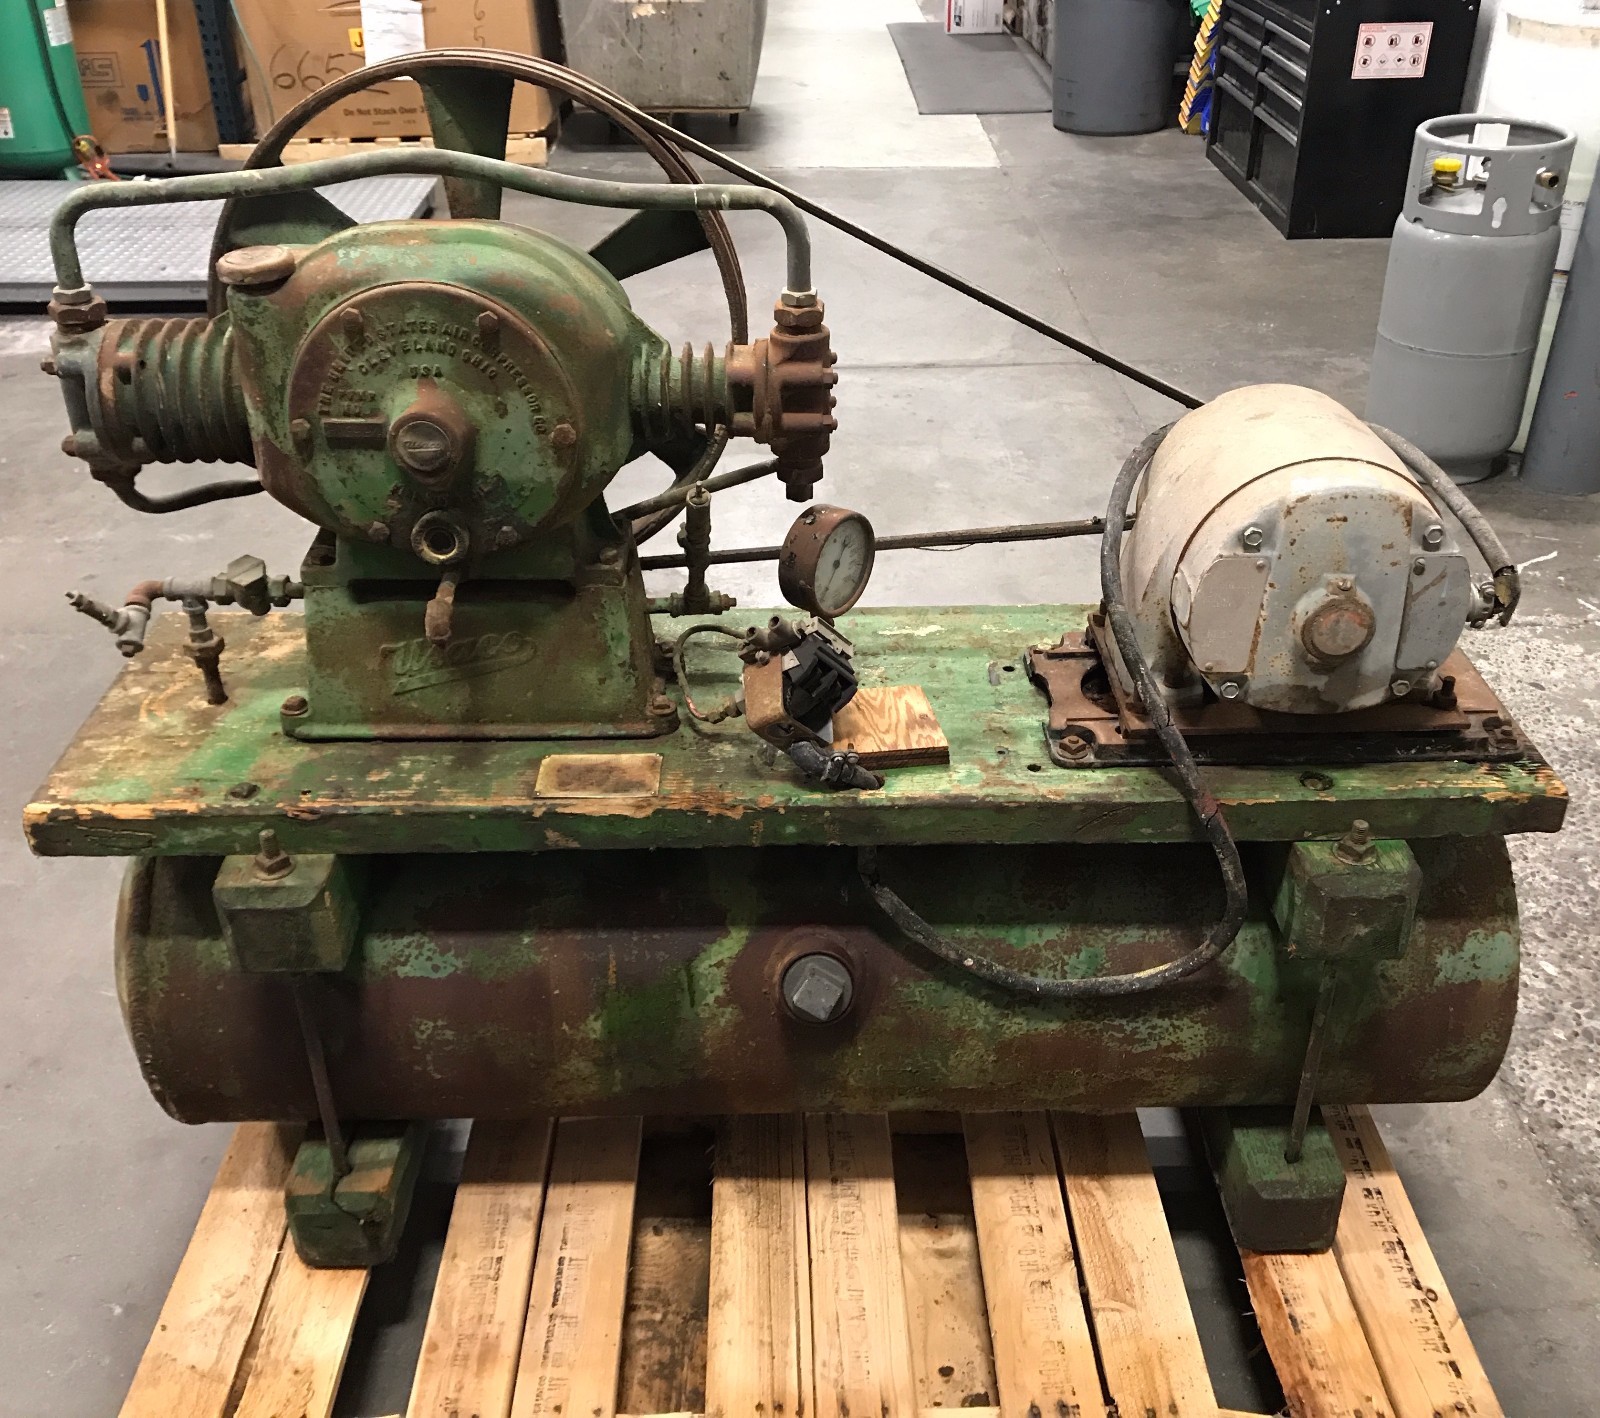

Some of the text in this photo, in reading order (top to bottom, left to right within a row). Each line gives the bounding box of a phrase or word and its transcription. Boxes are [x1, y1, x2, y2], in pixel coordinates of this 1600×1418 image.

[343, 108, 354, 116] Do
[356, 107, 371, 116] Not
[373, 106, 397, 116] Stack
[328, 331, 375, 383] UNITD
[376, 319, 439, 342] STATES
[441, 322, 471, 342] AIR
[358, 338, 498, 380] CLEVELAND OHIO
[408, 363, 444, 379] USA
